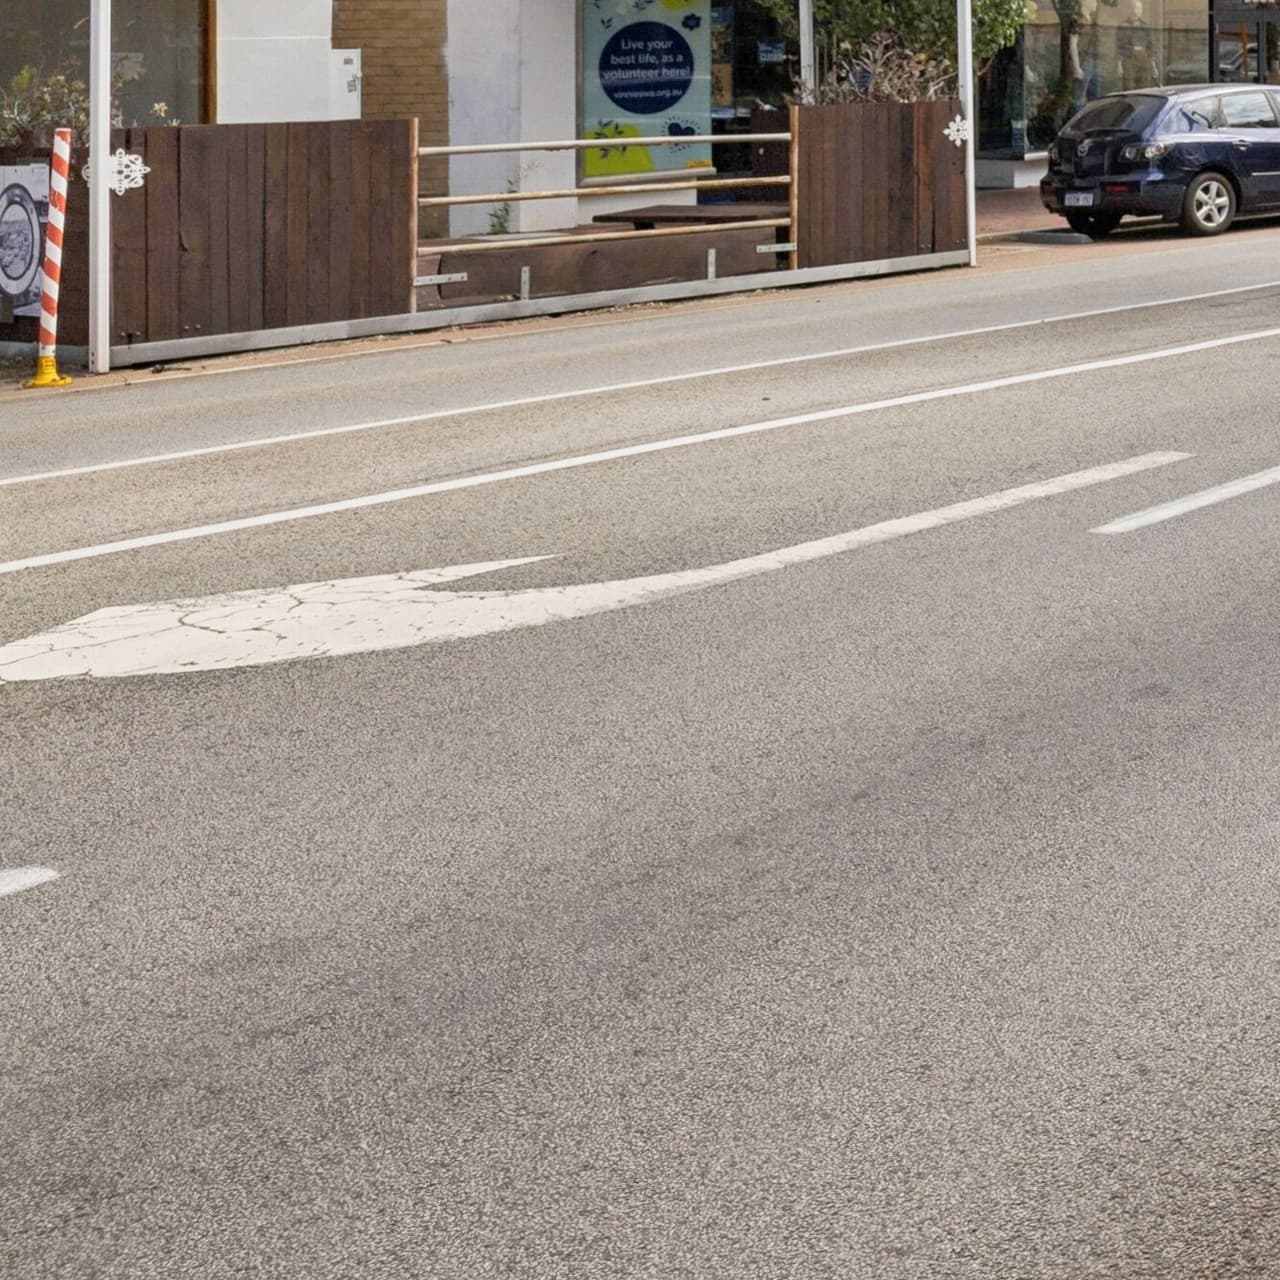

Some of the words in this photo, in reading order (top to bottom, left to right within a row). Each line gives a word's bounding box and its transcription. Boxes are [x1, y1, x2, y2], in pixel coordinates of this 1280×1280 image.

[621, 39, 645, 49] Live
[646, 40, 673, 51] your
[610, 53, 636, 64] best
[638, 53, 658, 64] life,
[661, 54, 674, 63] as
[676, 54, 683, 62] a
[603, 68, 660, 80] volunteer
[661, 66, 691, 78] here!
